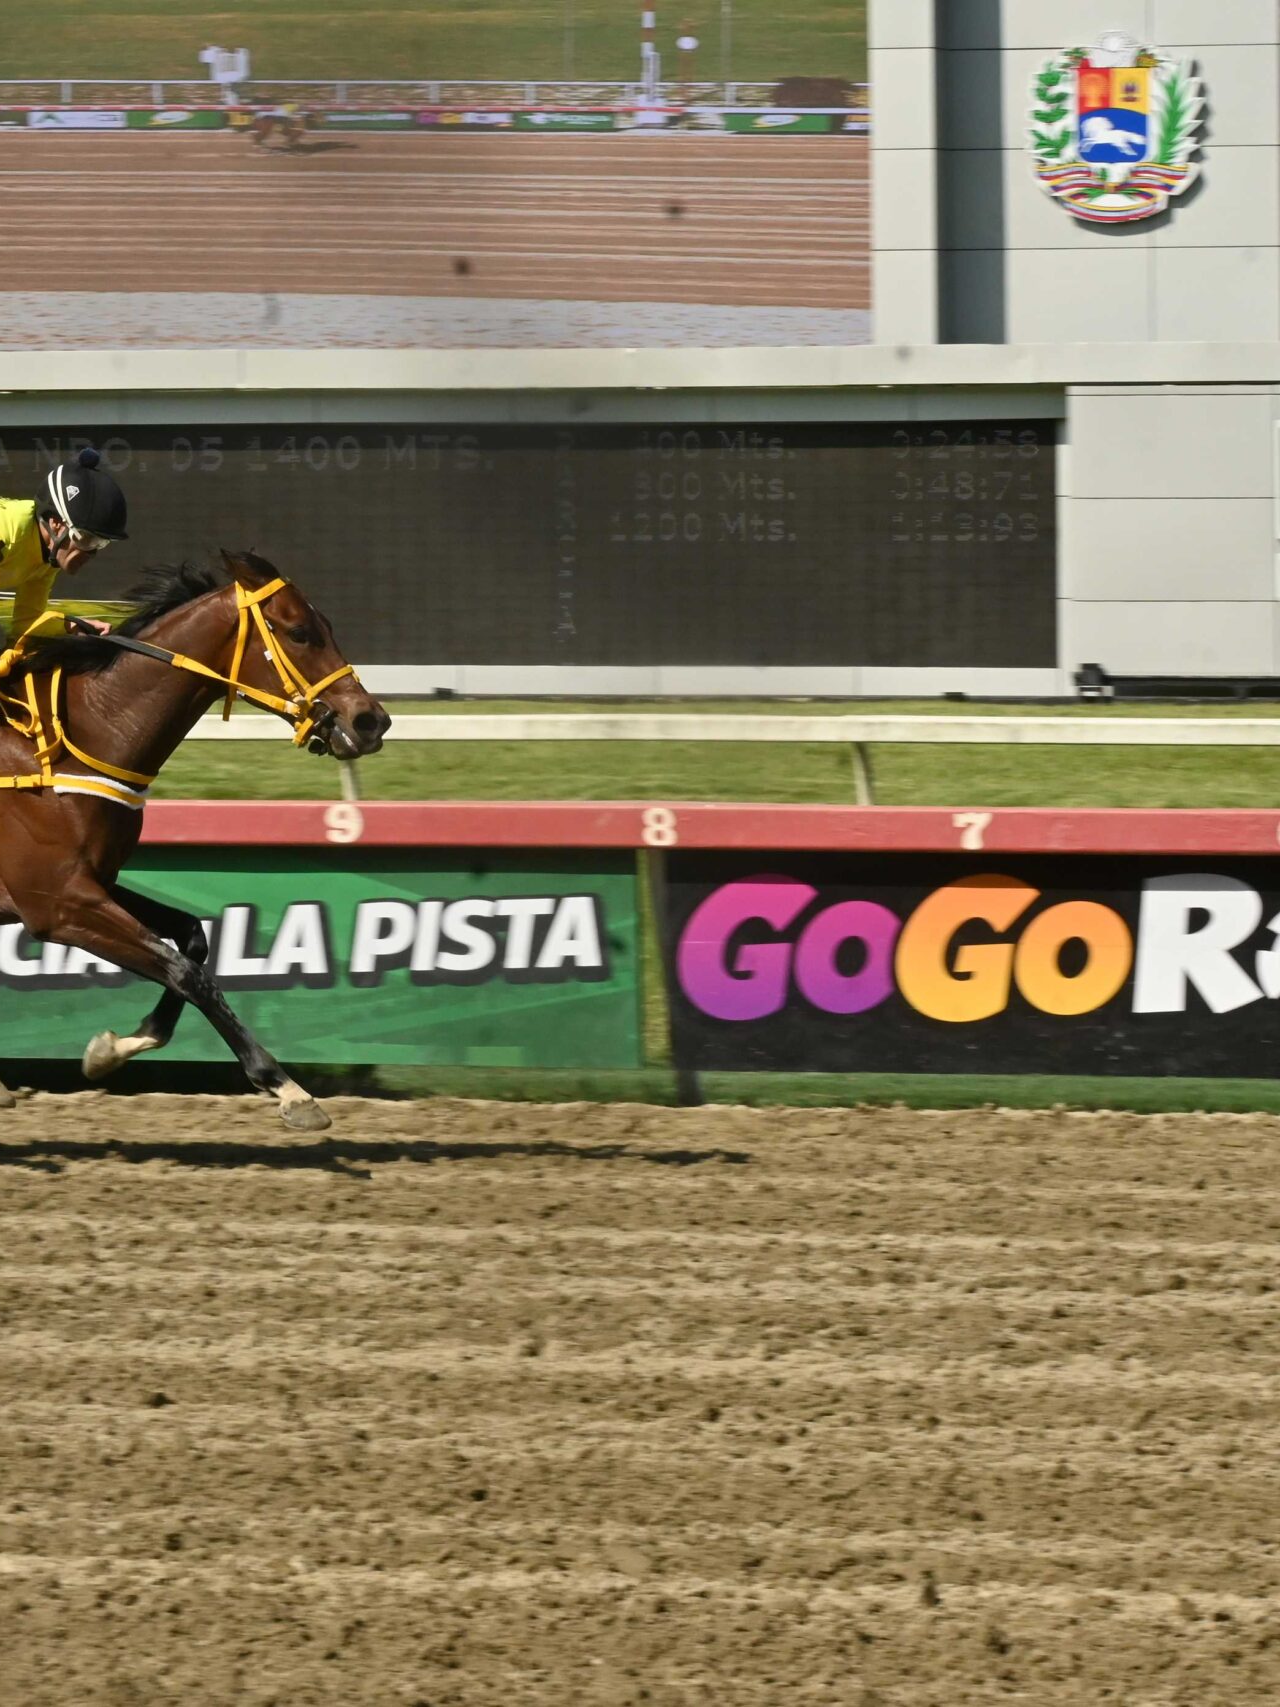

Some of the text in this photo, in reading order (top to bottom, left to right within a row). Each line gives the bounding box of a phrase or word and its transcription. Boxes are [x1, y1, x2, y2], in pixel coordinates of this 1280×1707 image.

[172, 436, 224, 472] 05
[245, 435, 362, 471] 1400
[384, 435, 495, 471] MTS.
[717, 431, 796, 459] Mts.
[717, 472, 796, 501] Mts.
[717, 512, 796, 541] Mts.
[323, 803, 365, 844] 9
[640, 807, 678, 847] 8
[952, 812, 993, 850] 7
[216, 903, 329, 977] LA
[349, 895, 603, 973] PISTA
[676, 873, 1280, 1022] GoGoR
